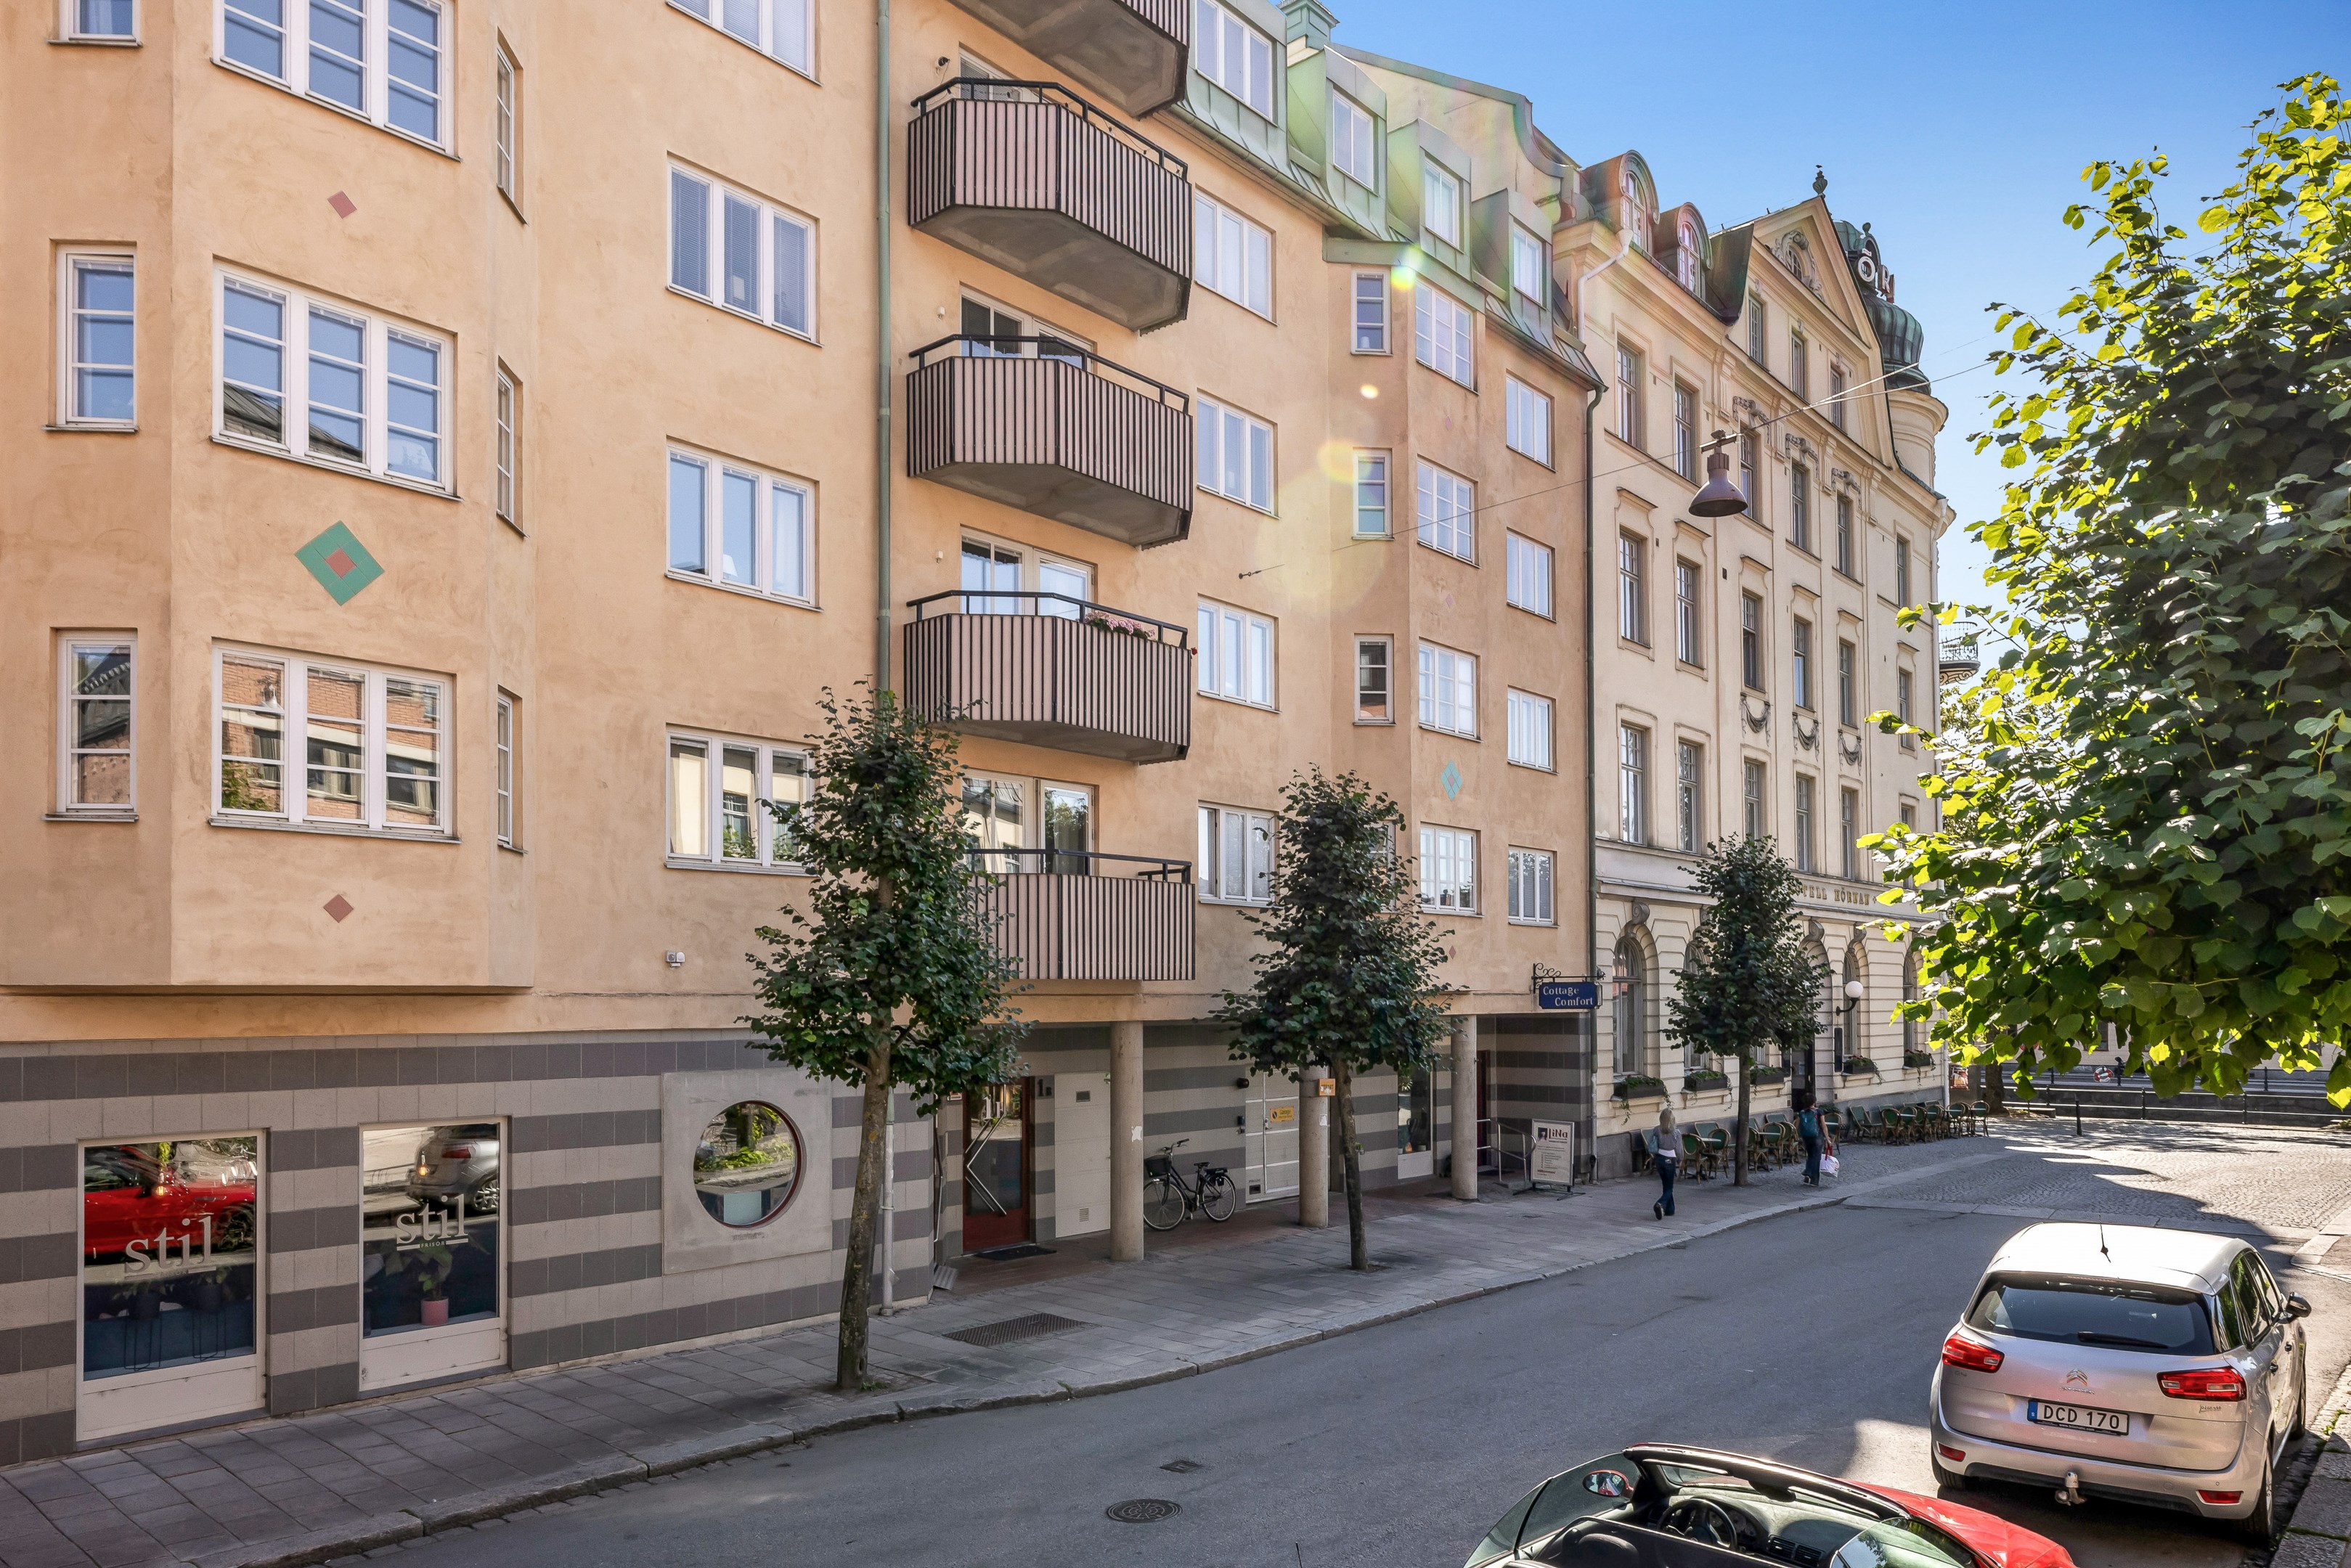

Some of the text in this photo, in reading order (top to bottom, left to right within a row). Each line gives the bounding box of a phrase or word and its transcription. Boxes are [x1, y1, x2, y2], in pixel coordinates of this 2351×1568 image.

[1543, 986, 1580, 997] Cottage
[1555, 997, 1593, 1007] Comfort
[396, 1193, 468, 1244] stil
[124, 1215, 216, 1274] stil
[2043, 1405, 2120, 1429] DCD 170
